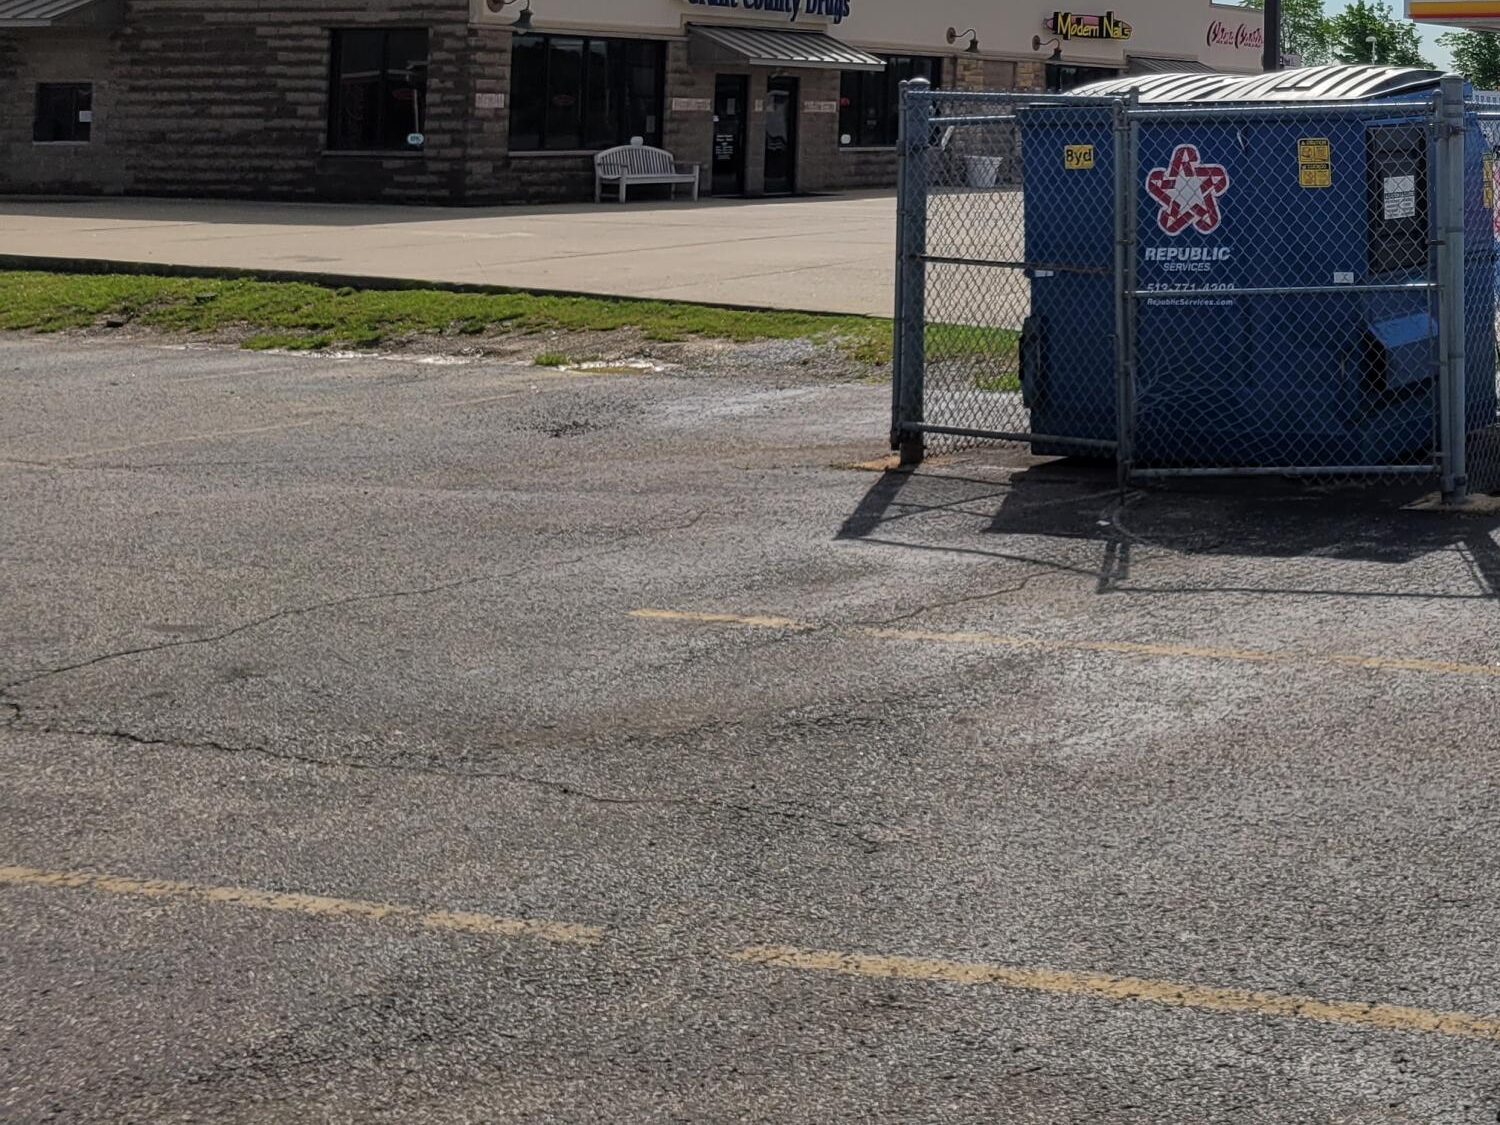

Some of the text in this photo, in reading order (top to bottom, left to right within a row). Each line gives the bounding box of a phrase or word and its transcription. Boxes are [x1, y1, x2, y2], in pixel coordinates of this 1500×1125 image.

[1057, 11, 1133, 40] Modern Nails
[1144, 247, 1231, 261] REPUBLIC
[1163, 263, 1211, 271] SERVICES
